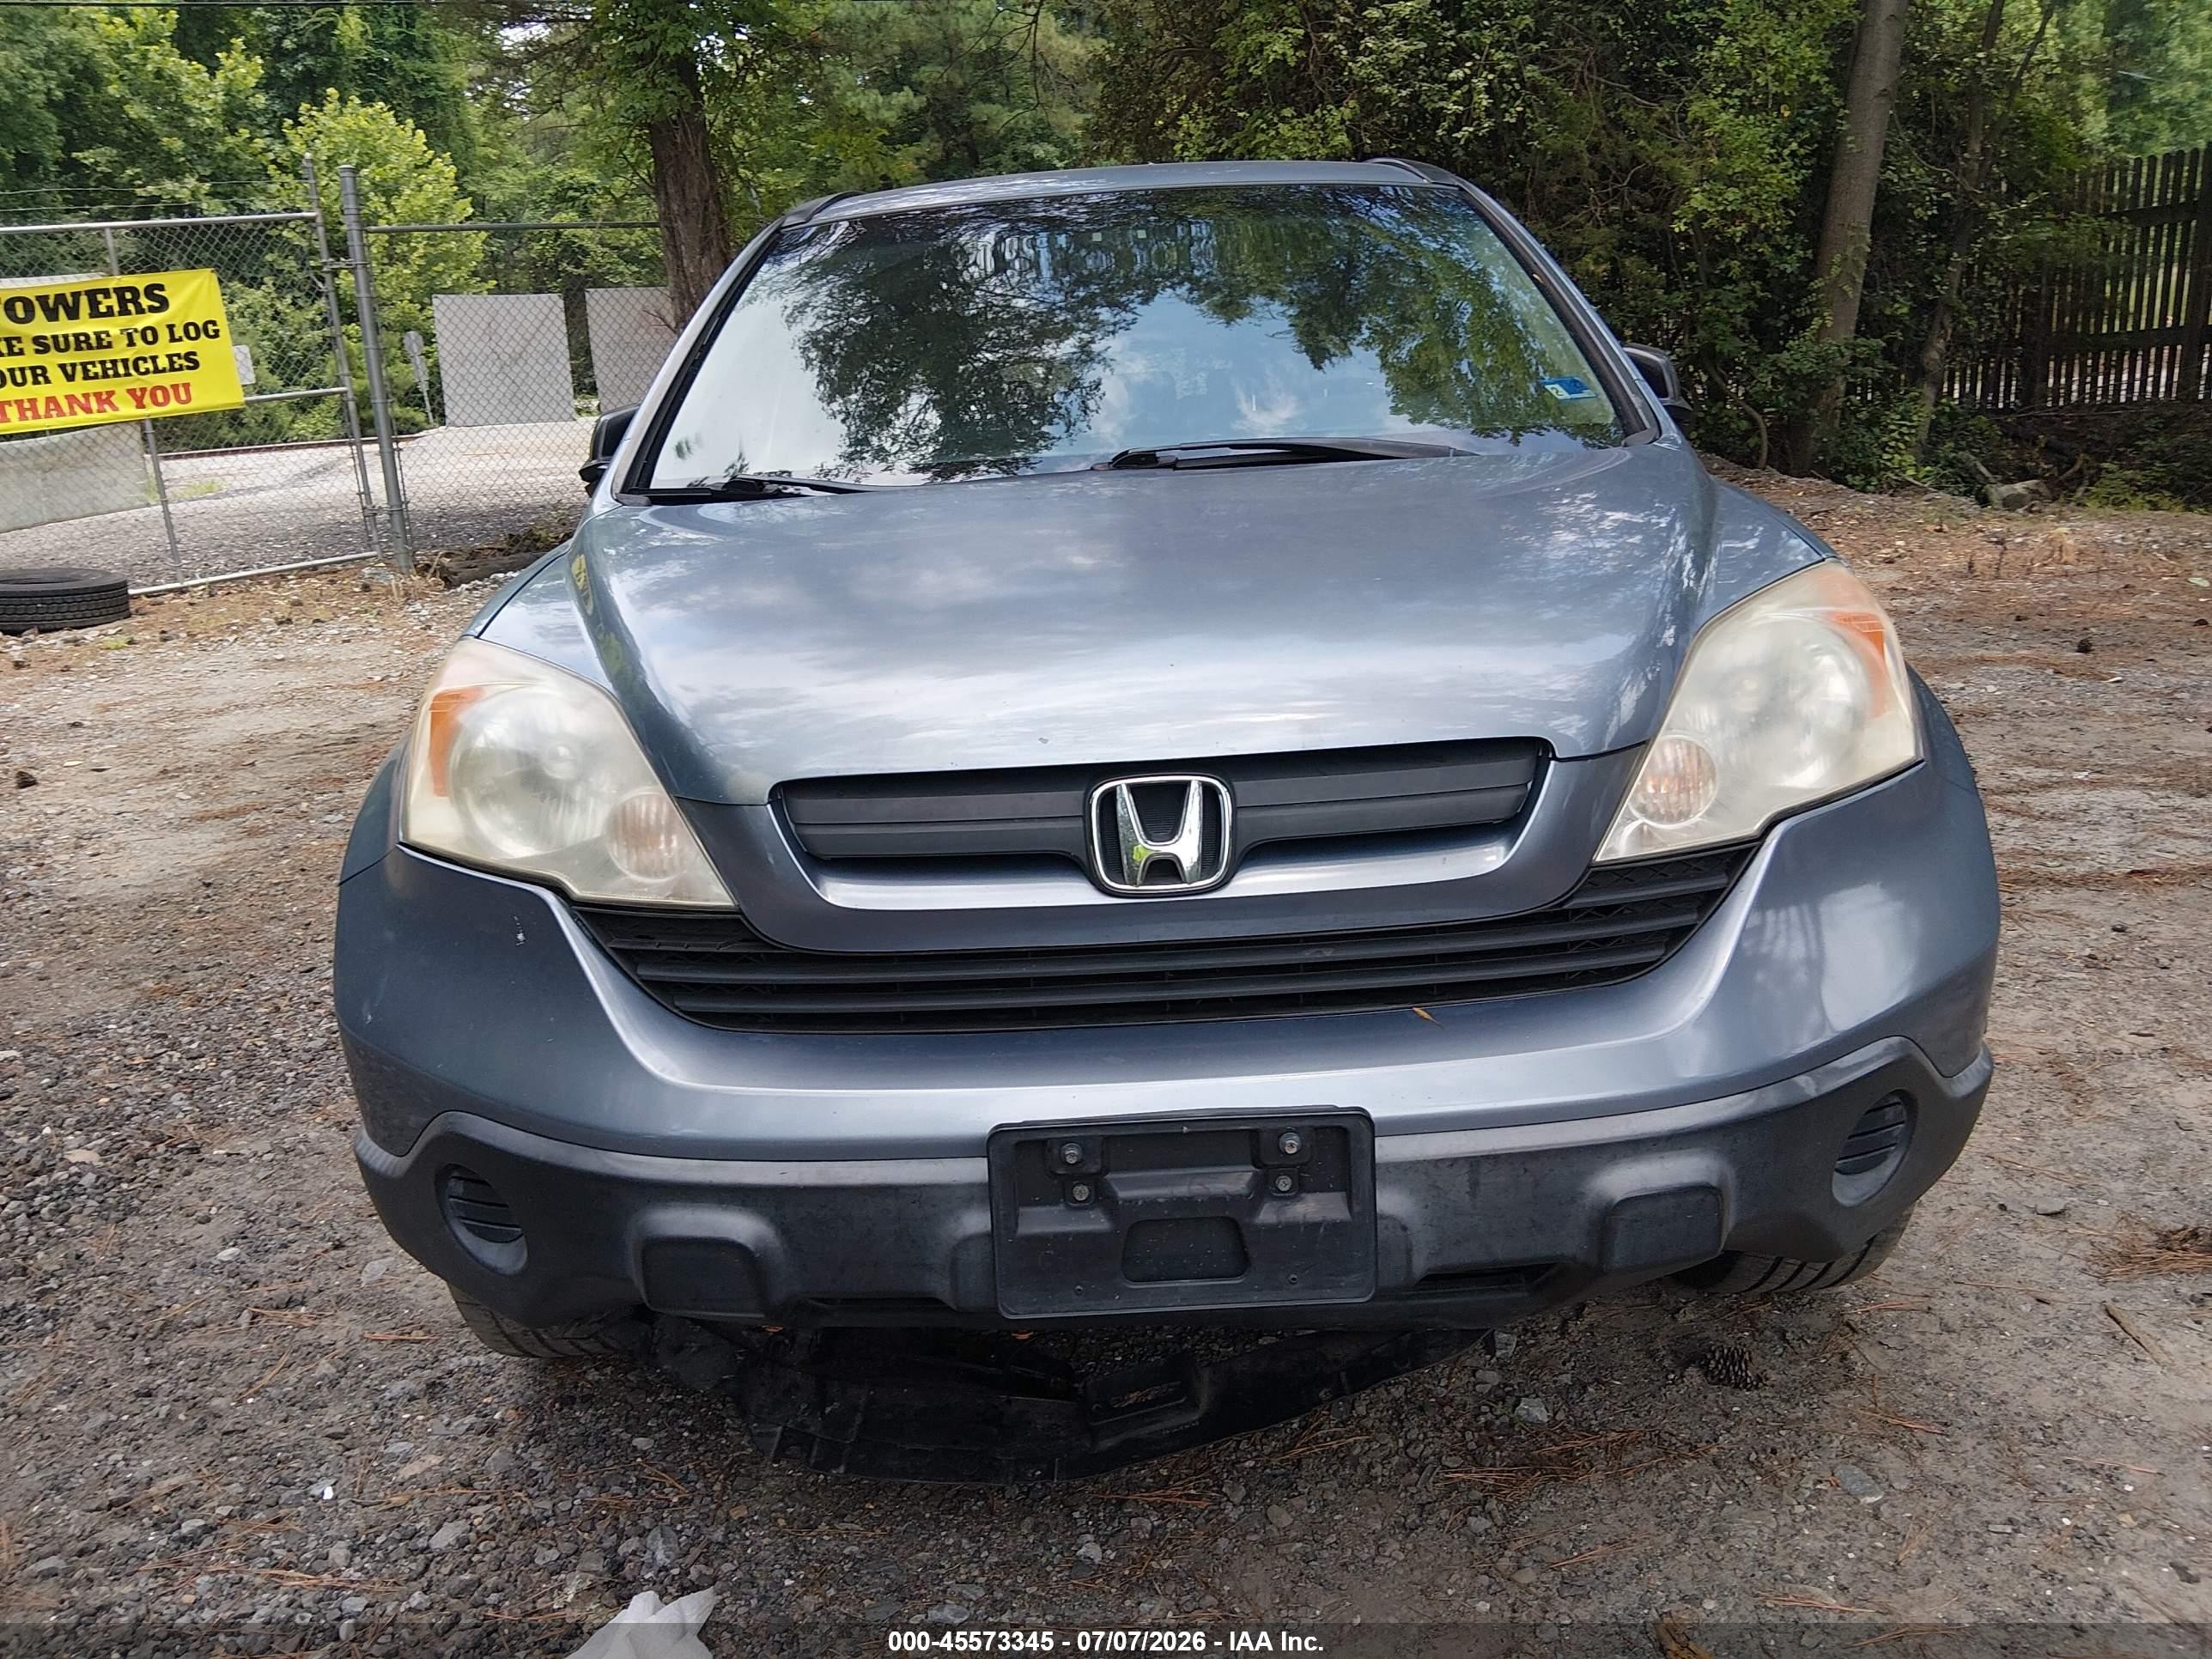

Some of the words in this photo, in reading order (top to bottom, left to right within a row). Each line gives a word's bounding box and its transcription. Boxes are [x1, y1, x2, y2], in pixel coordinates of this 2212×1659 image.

[0, 283, 169, 324] OWERS
[32, 331, 113, 355] SURE
[119, 325, 159, 348] TO
[166, 319, 221, 343] LOG
[58, 351, 200, 383] VEHICLES
[126, 382, 192, 410] YOU
